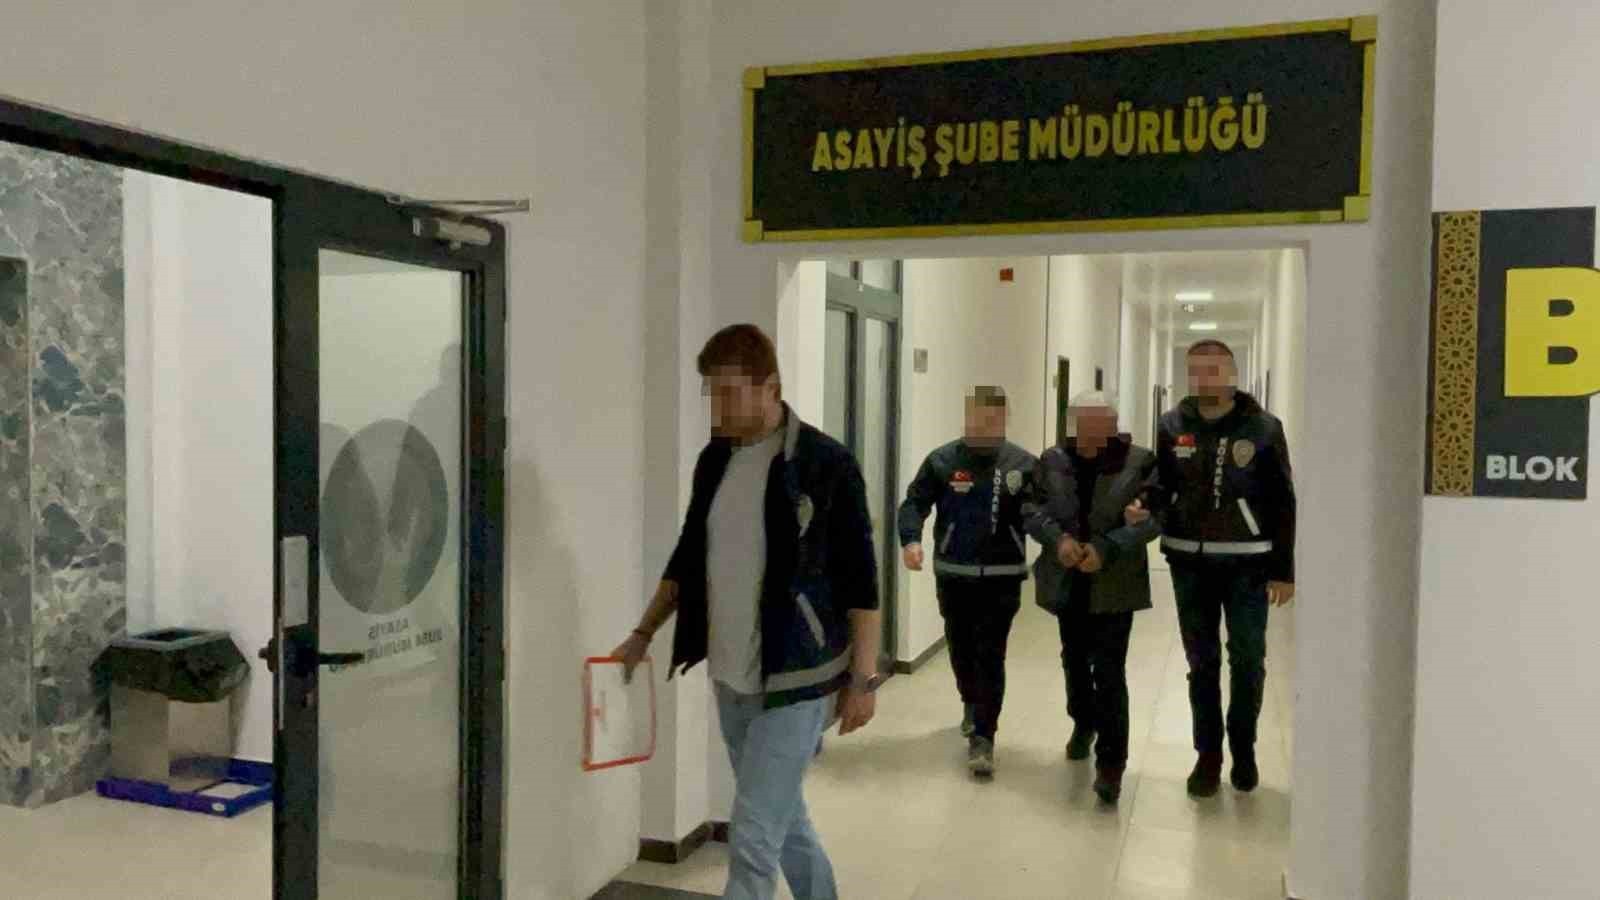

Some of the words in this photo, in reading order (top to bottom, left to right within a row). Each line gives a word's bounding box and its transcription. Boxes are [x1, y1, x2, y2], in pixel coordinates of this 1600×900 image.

[811, 116, 927, 179] ASAYİŞ
[934, 119, 1020, 177] ŞUBE
[1027, 92, 1268, 161] MÜDÜRLÜĞÜ
[1503, 266, 1600, 398] B
[1485, 454, 1579, 482] BLOK
